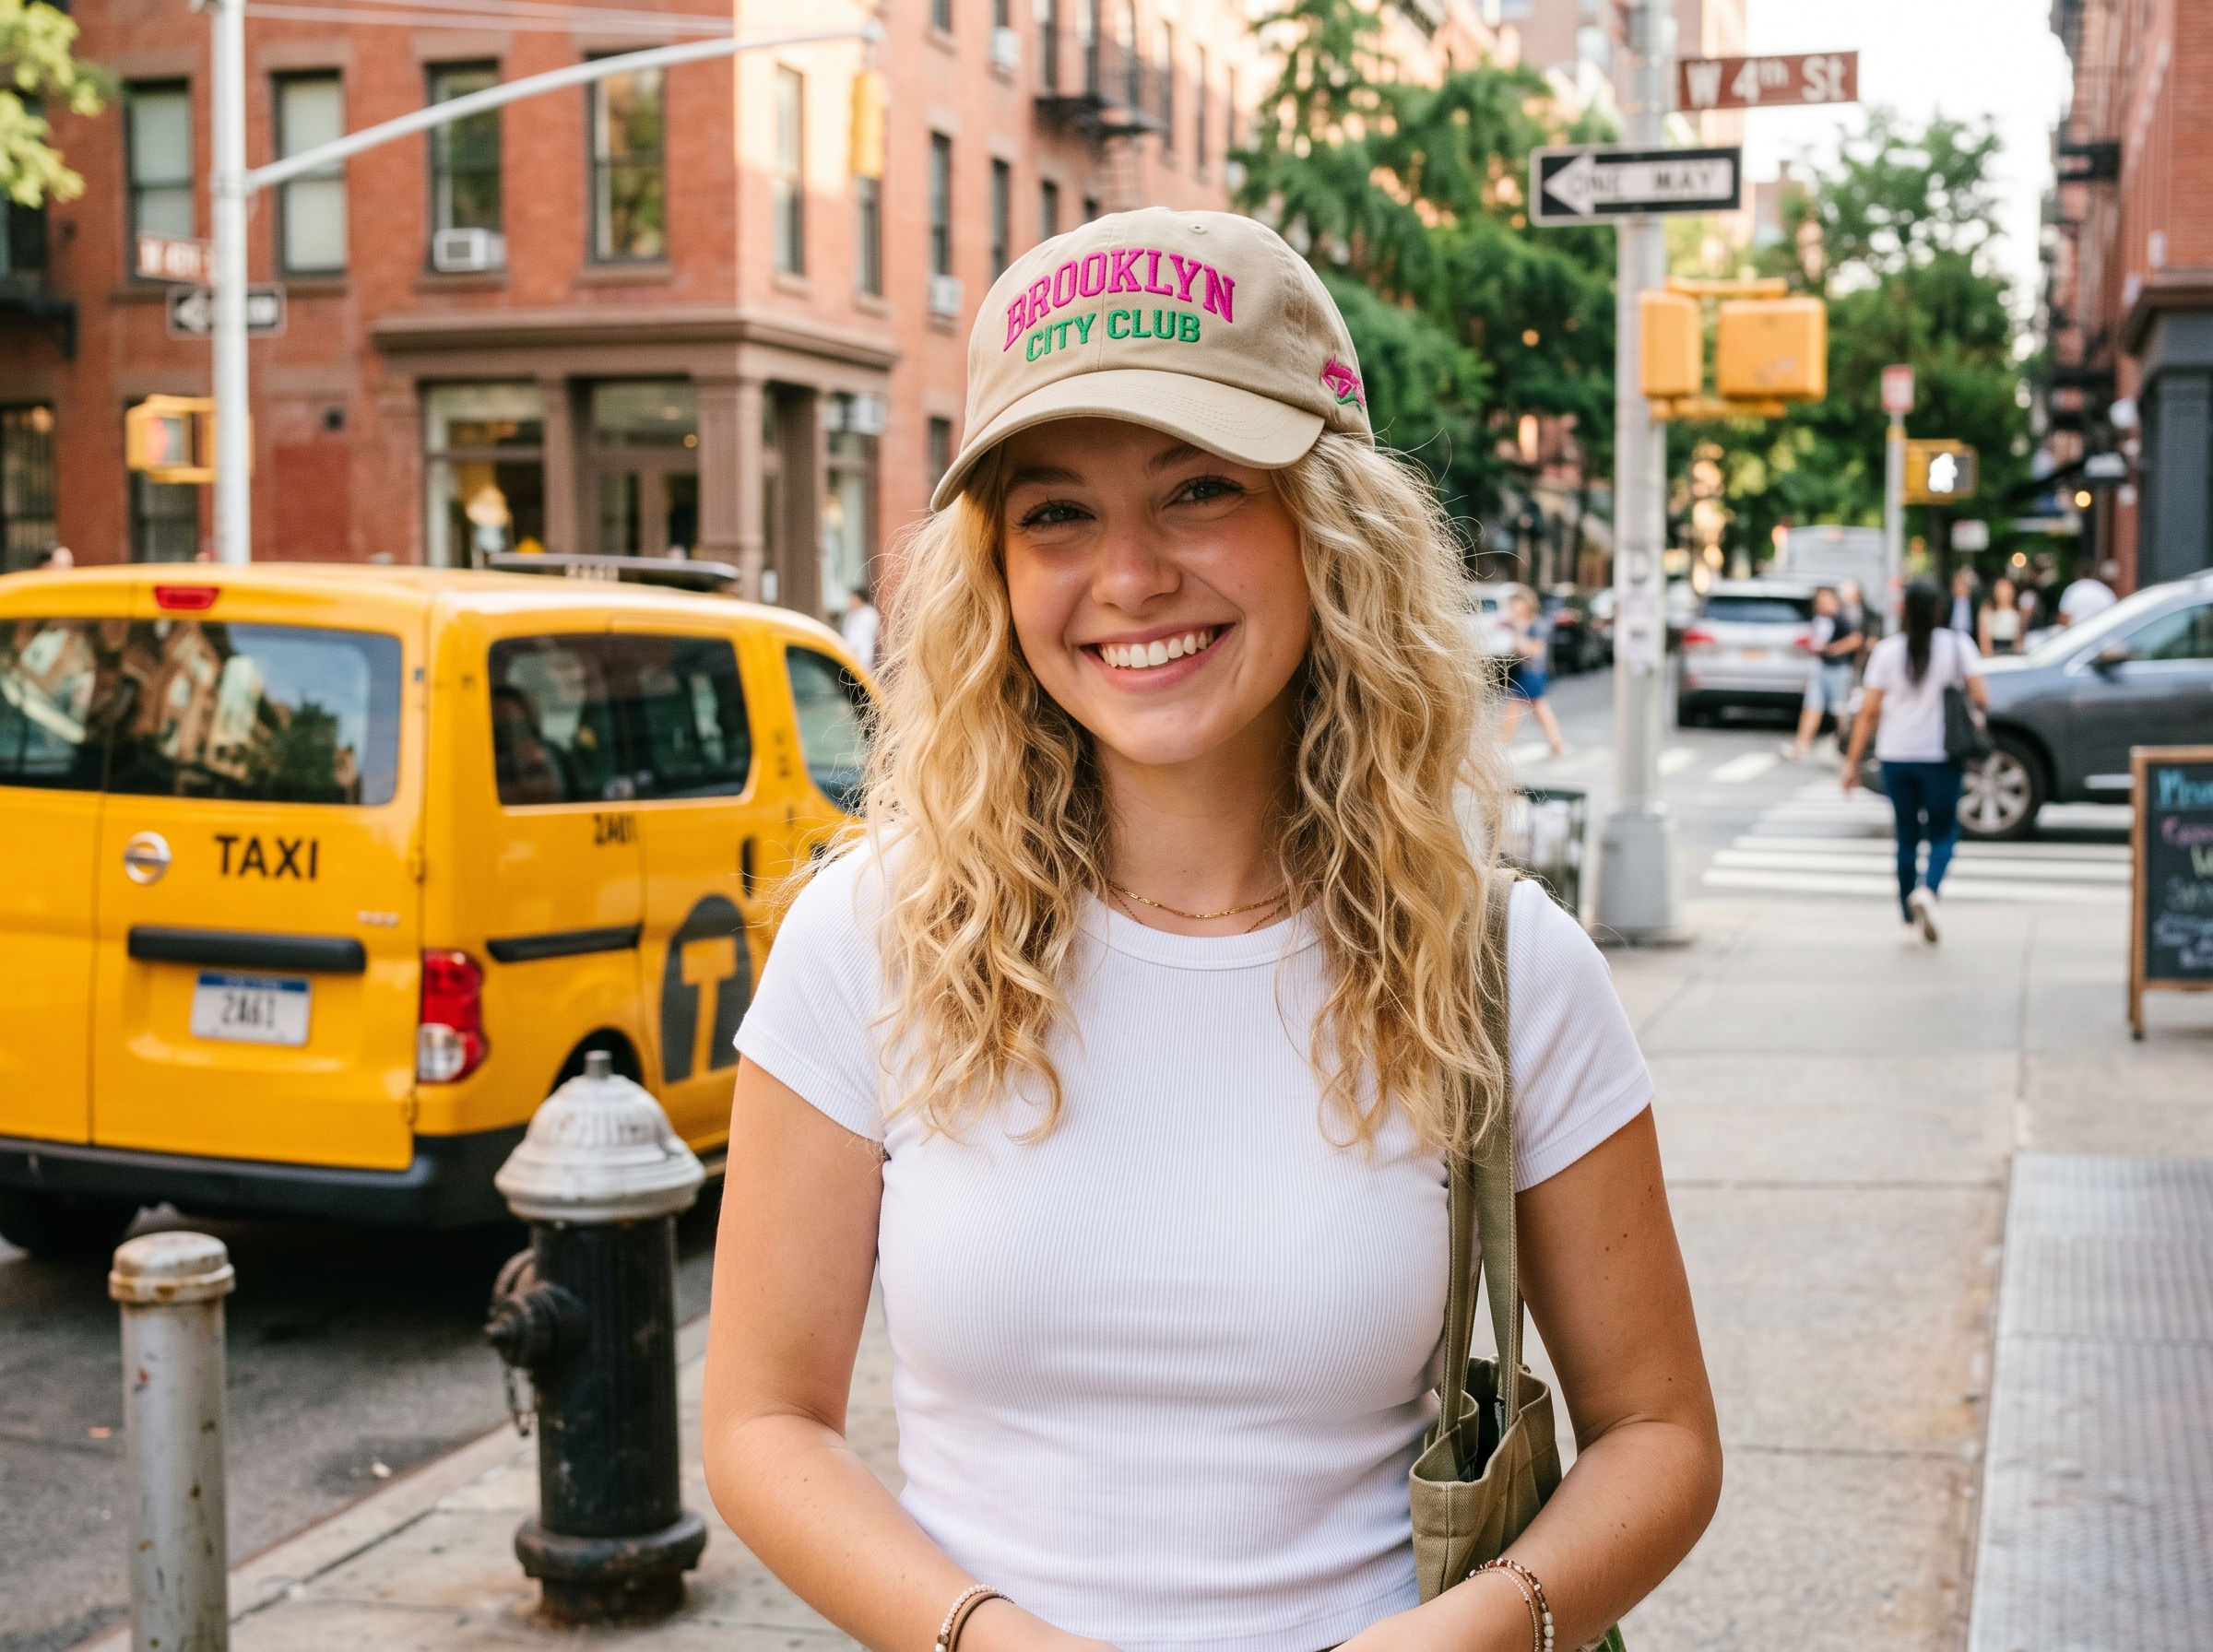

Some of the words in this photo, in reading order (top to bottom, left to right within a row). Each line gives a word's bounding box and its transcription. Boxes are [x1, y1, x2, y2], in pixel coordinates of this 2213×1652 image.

[1686, 60, 1722, 110] W
[1731, 58, 1790, 106] 4th
[1801, 54, 1845, 103] St
[1565, 169, 1620, 196] ONE
[1003, 249, 1235, 352] BROOKLYN
[1025, 313, 1096, 362] CITY
[1107, 309, 1201, 343] CLUB
[213, 832, 319, 881] TAXI
[681, 935, 737, 1077] T
